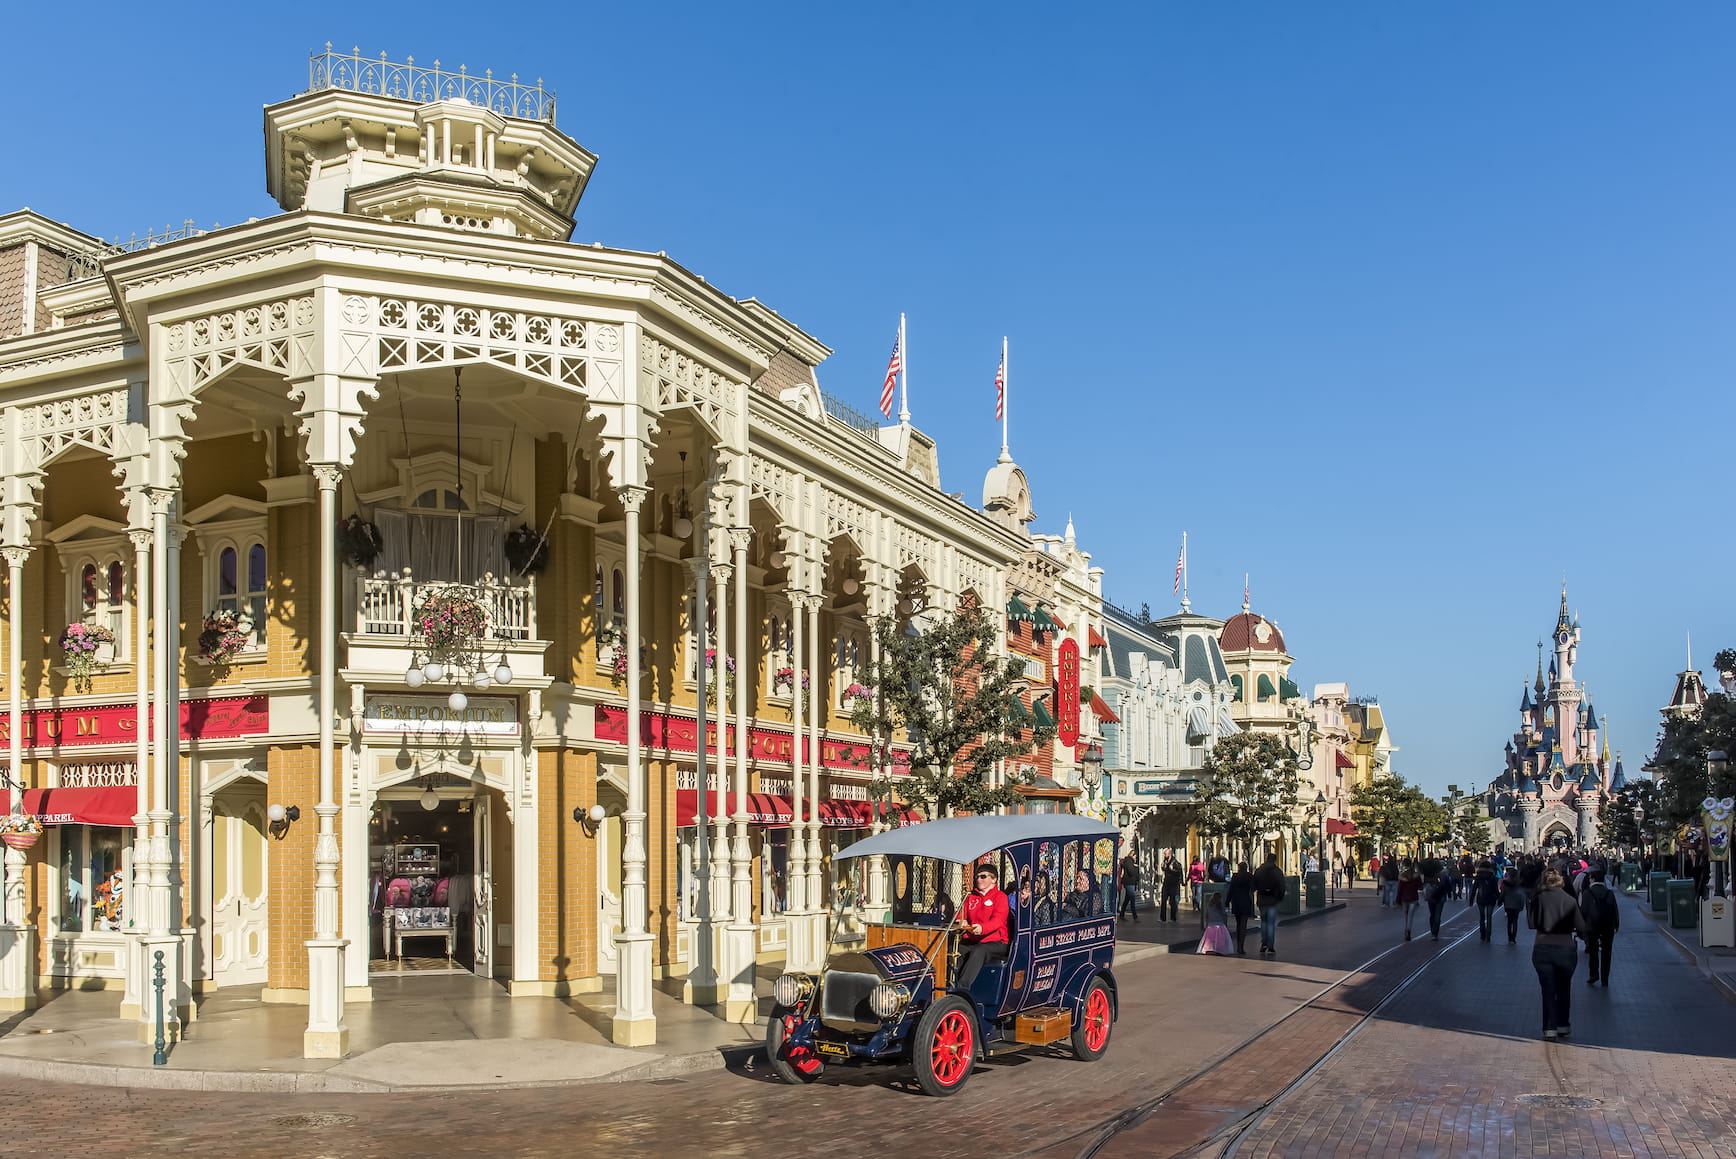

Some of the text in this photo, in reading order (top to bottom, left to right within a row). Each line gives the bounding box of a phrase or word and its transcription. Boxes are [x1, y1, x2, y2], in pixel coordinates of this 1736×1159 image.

[1063, 651, 1073, 732] EMPORIUM
[378, 704, 505, 722] EMPORIUM
[706, 730, 836, 761] EPORM
[830, 817, 854, 825] TOYS
[880, 950, 923, 968] POLICE
